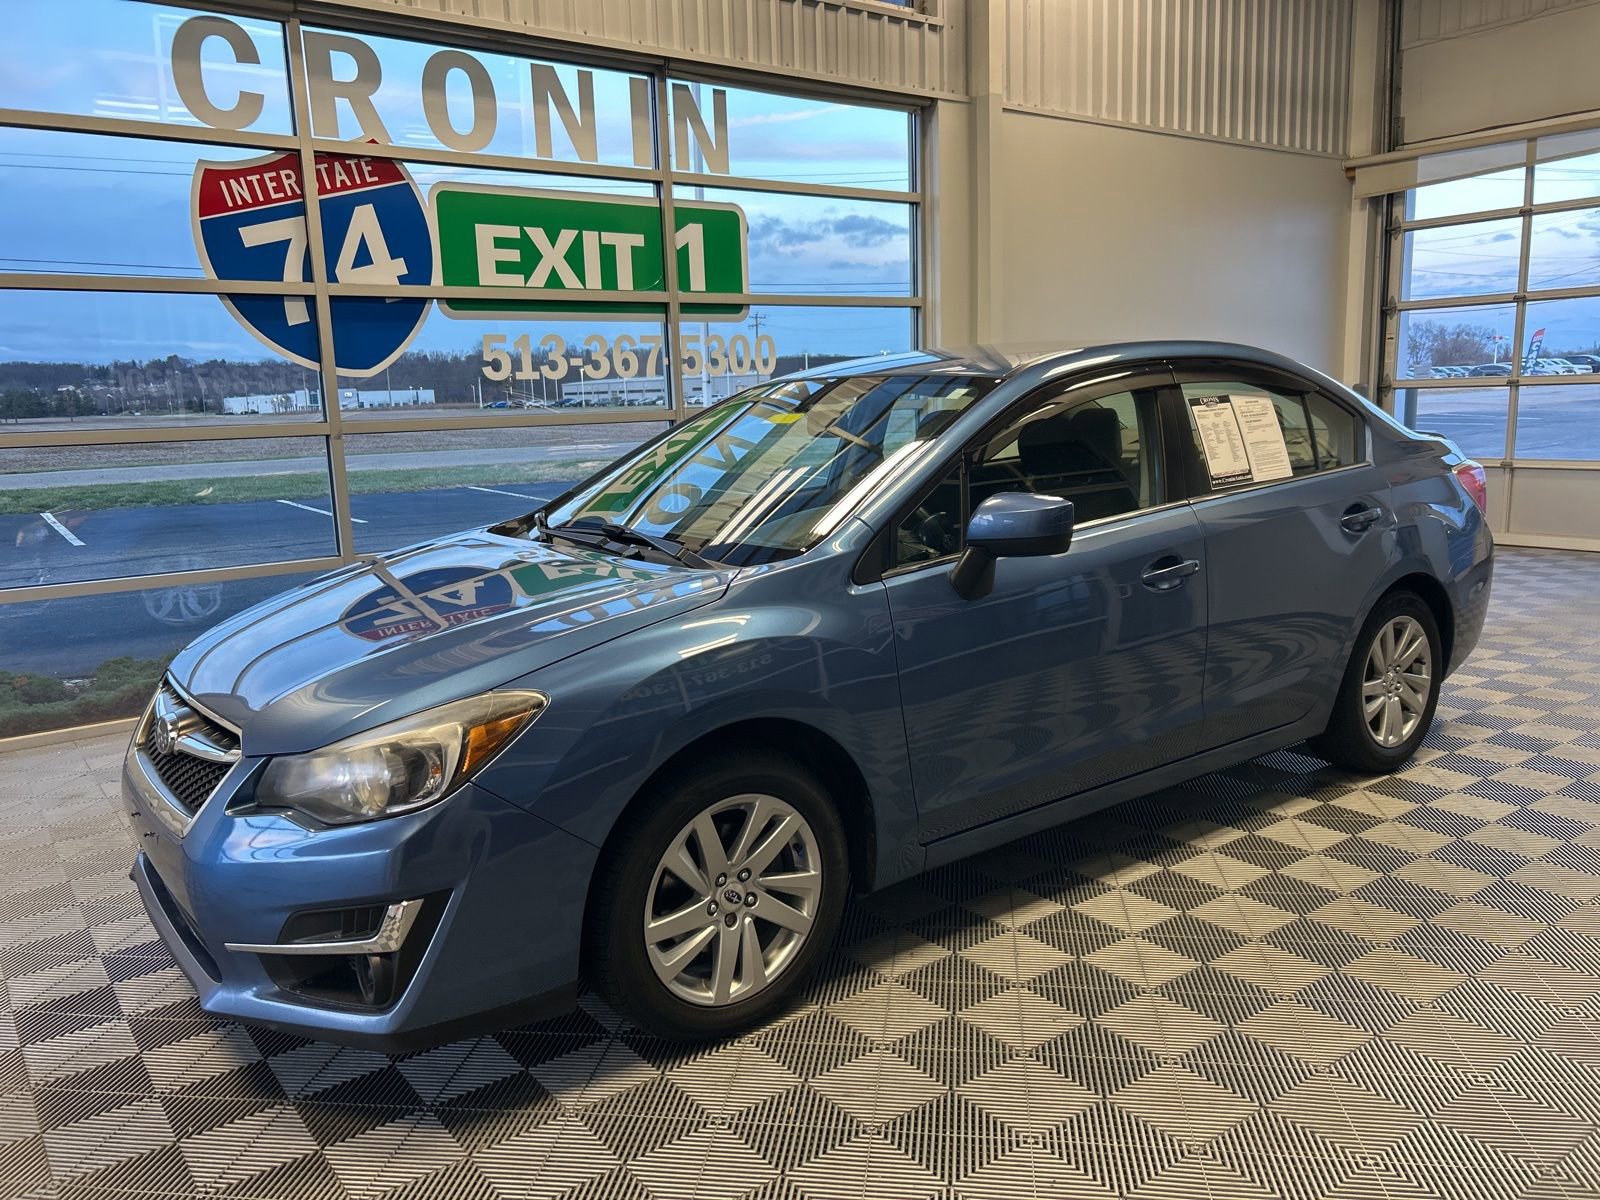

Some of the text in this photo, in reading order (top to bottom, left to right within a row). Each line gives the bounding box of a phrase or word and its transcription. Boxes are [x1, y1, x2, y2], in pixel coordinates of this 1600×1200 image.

[171, 15, 730, 174] CRONIN
[218, 157, 380, 208] INTERTATE
[238, 203, 409, 327] 74
[475, 223, 706, 291] EXIT 1
